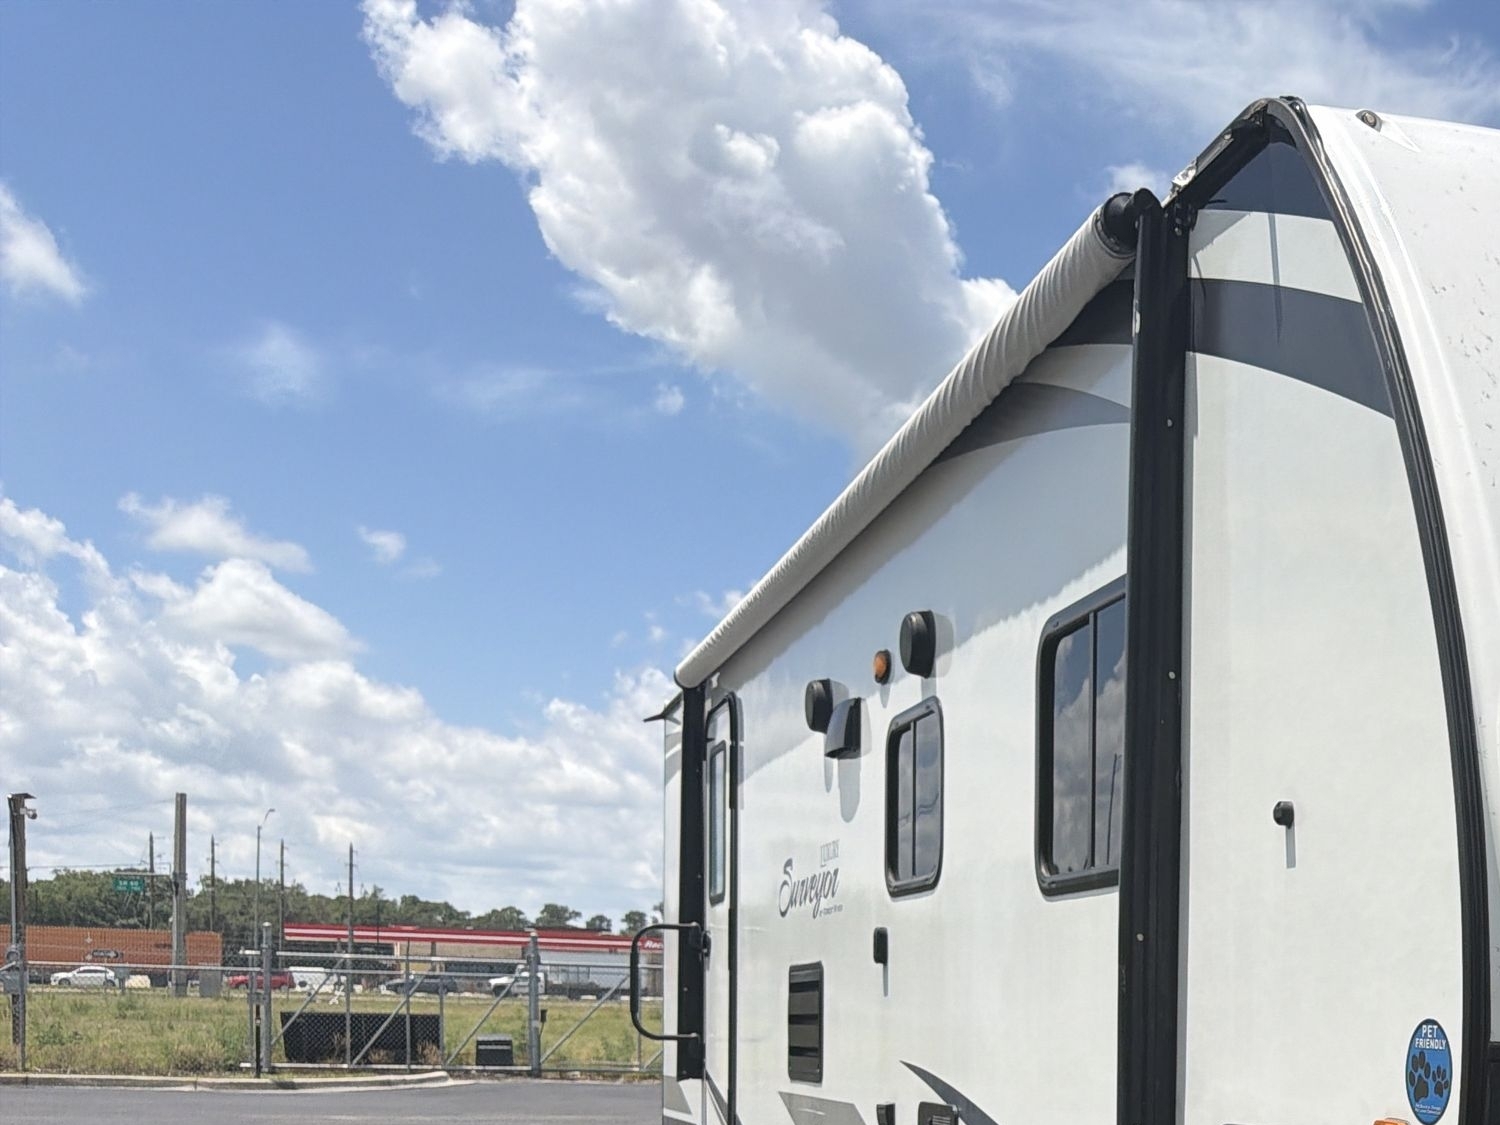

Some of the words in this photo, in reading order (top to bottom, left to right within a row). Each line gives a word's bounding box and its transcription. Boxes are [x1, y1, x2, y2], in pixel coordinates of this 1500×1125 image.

[779, 857, 840, 919] Surveyor
[1421, 1024, 1438, 1038] PET
[1414, 1037, 1447, 1050] FRIENDLY
